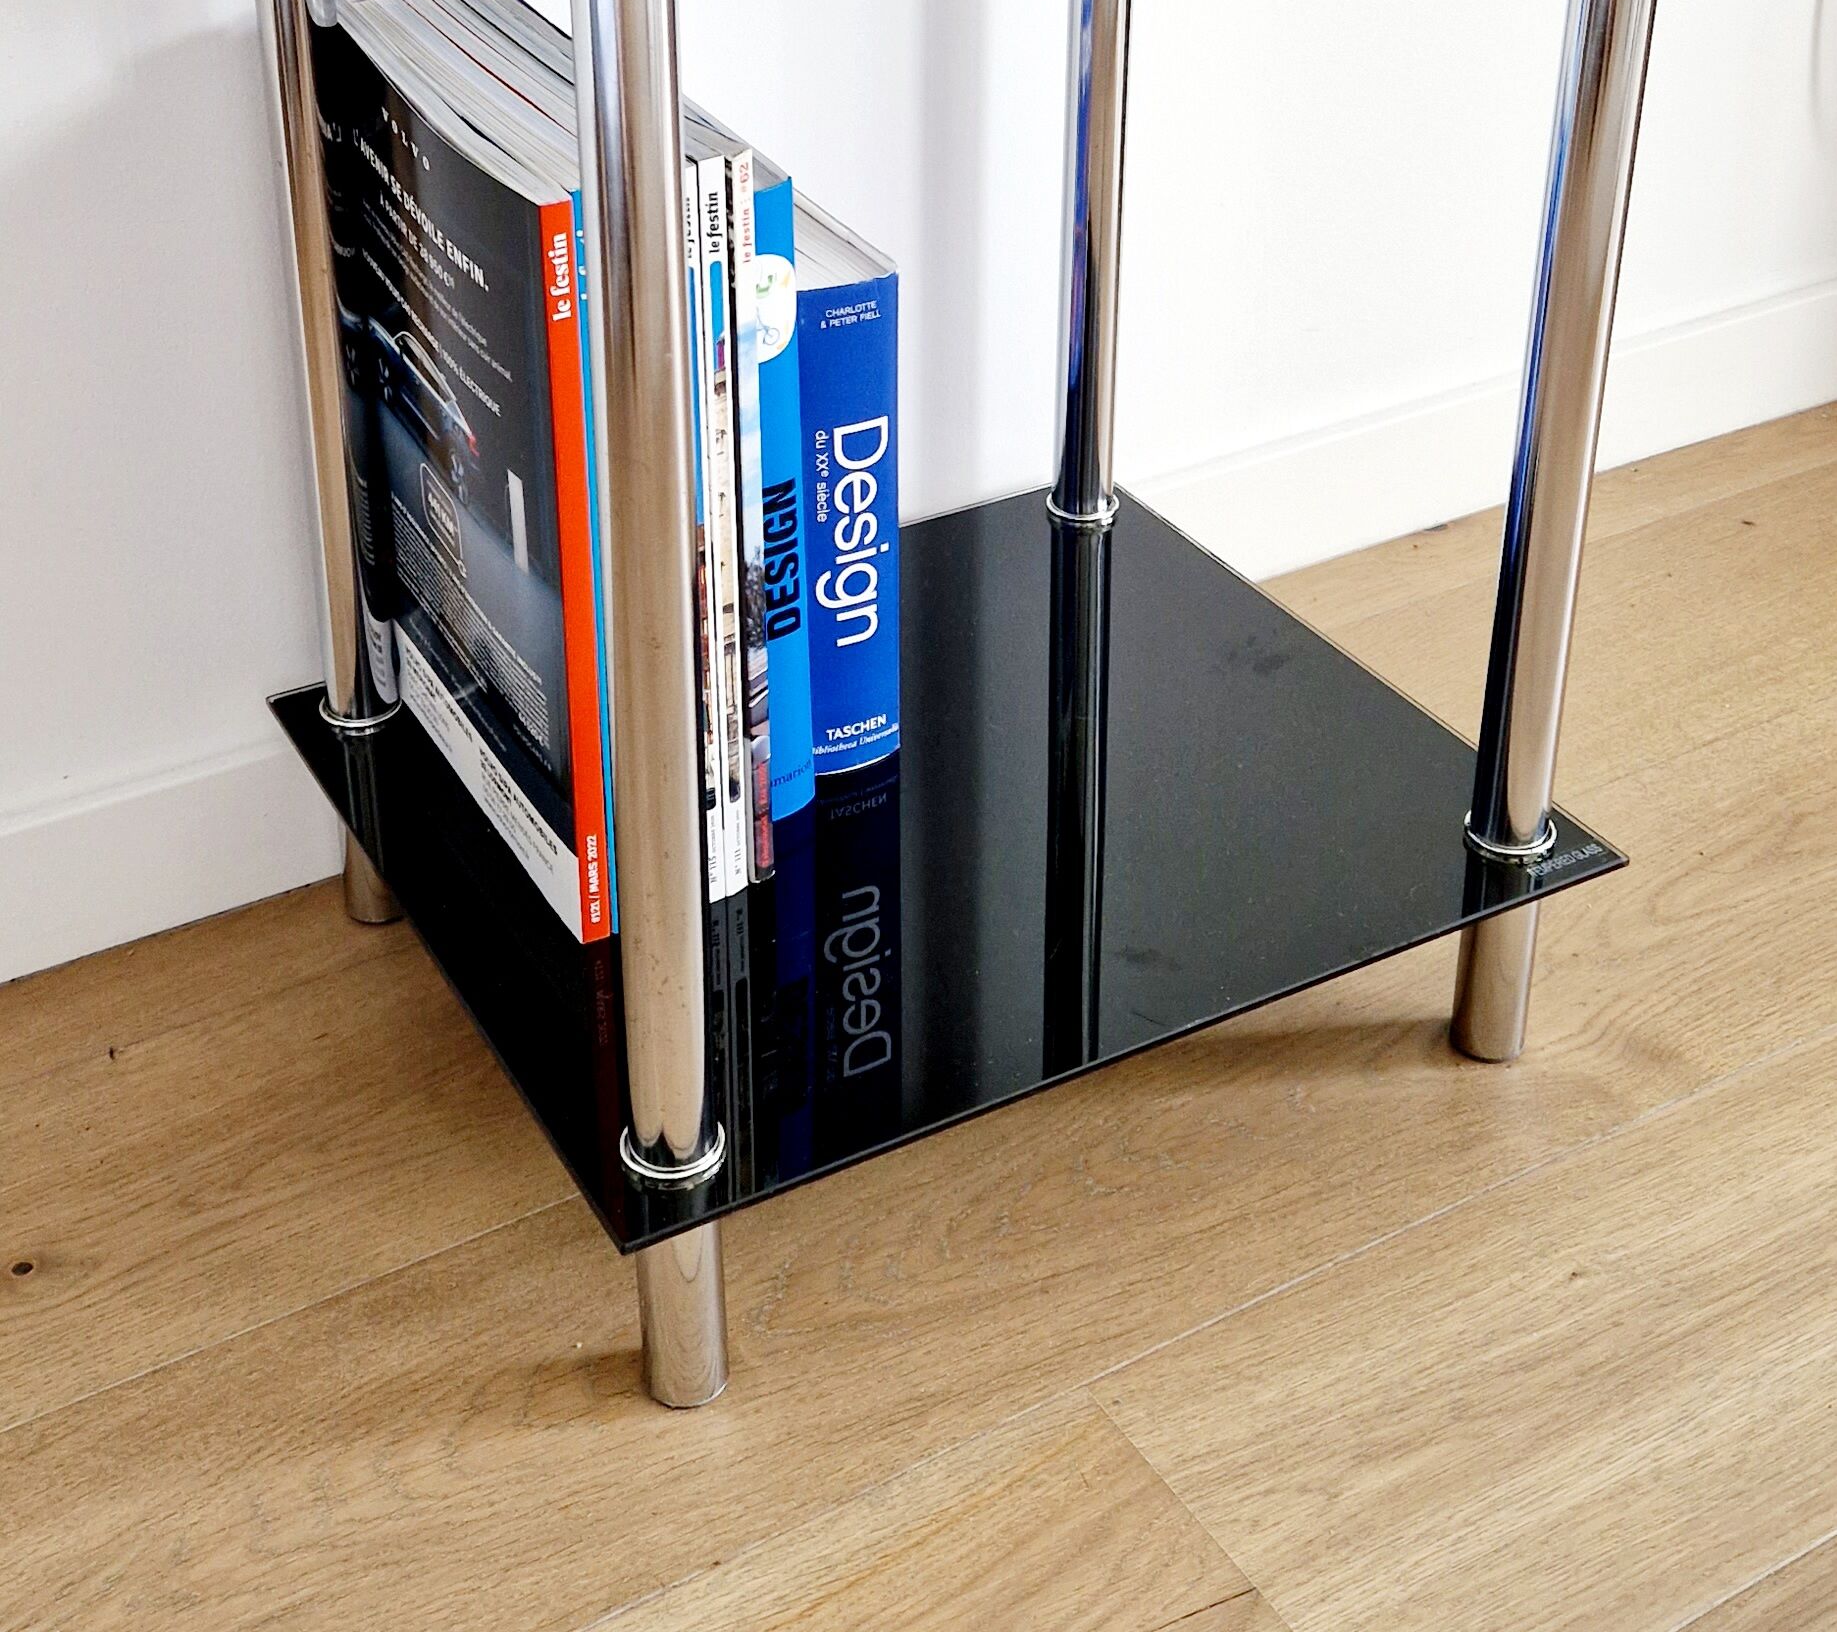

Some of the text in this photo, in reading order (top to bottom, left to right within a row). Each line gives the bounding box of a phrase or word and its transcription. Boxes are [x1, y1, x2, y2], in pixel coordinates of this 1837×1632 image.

[382, 106, 430, 171] VOLVO
[390, 174, 402, 203] SE
[403, 191, 445, 253] DÉVOILE
[446, 239, 489, 292] ENFIN.
[705, 192, 723, 254] le festin
[742, 209, 752, 247] festin
[547, 231, 572, 321] le festin
[743, 251, 751, 263] le
[825, 300, 877, 318] CHARLOTTE
[830, 315, 857, 328] PETER
[815, 430, 829, 449] du
[816, 482, 831, 523] siècle
[815, 415, 889, 648] Design
[762, 477, 801, 642] DESIGN
[826, 714, 887, 741] TASCHEN
[586, 834, 598, 861] 2022
[588, 862, 599, 893] MARS
